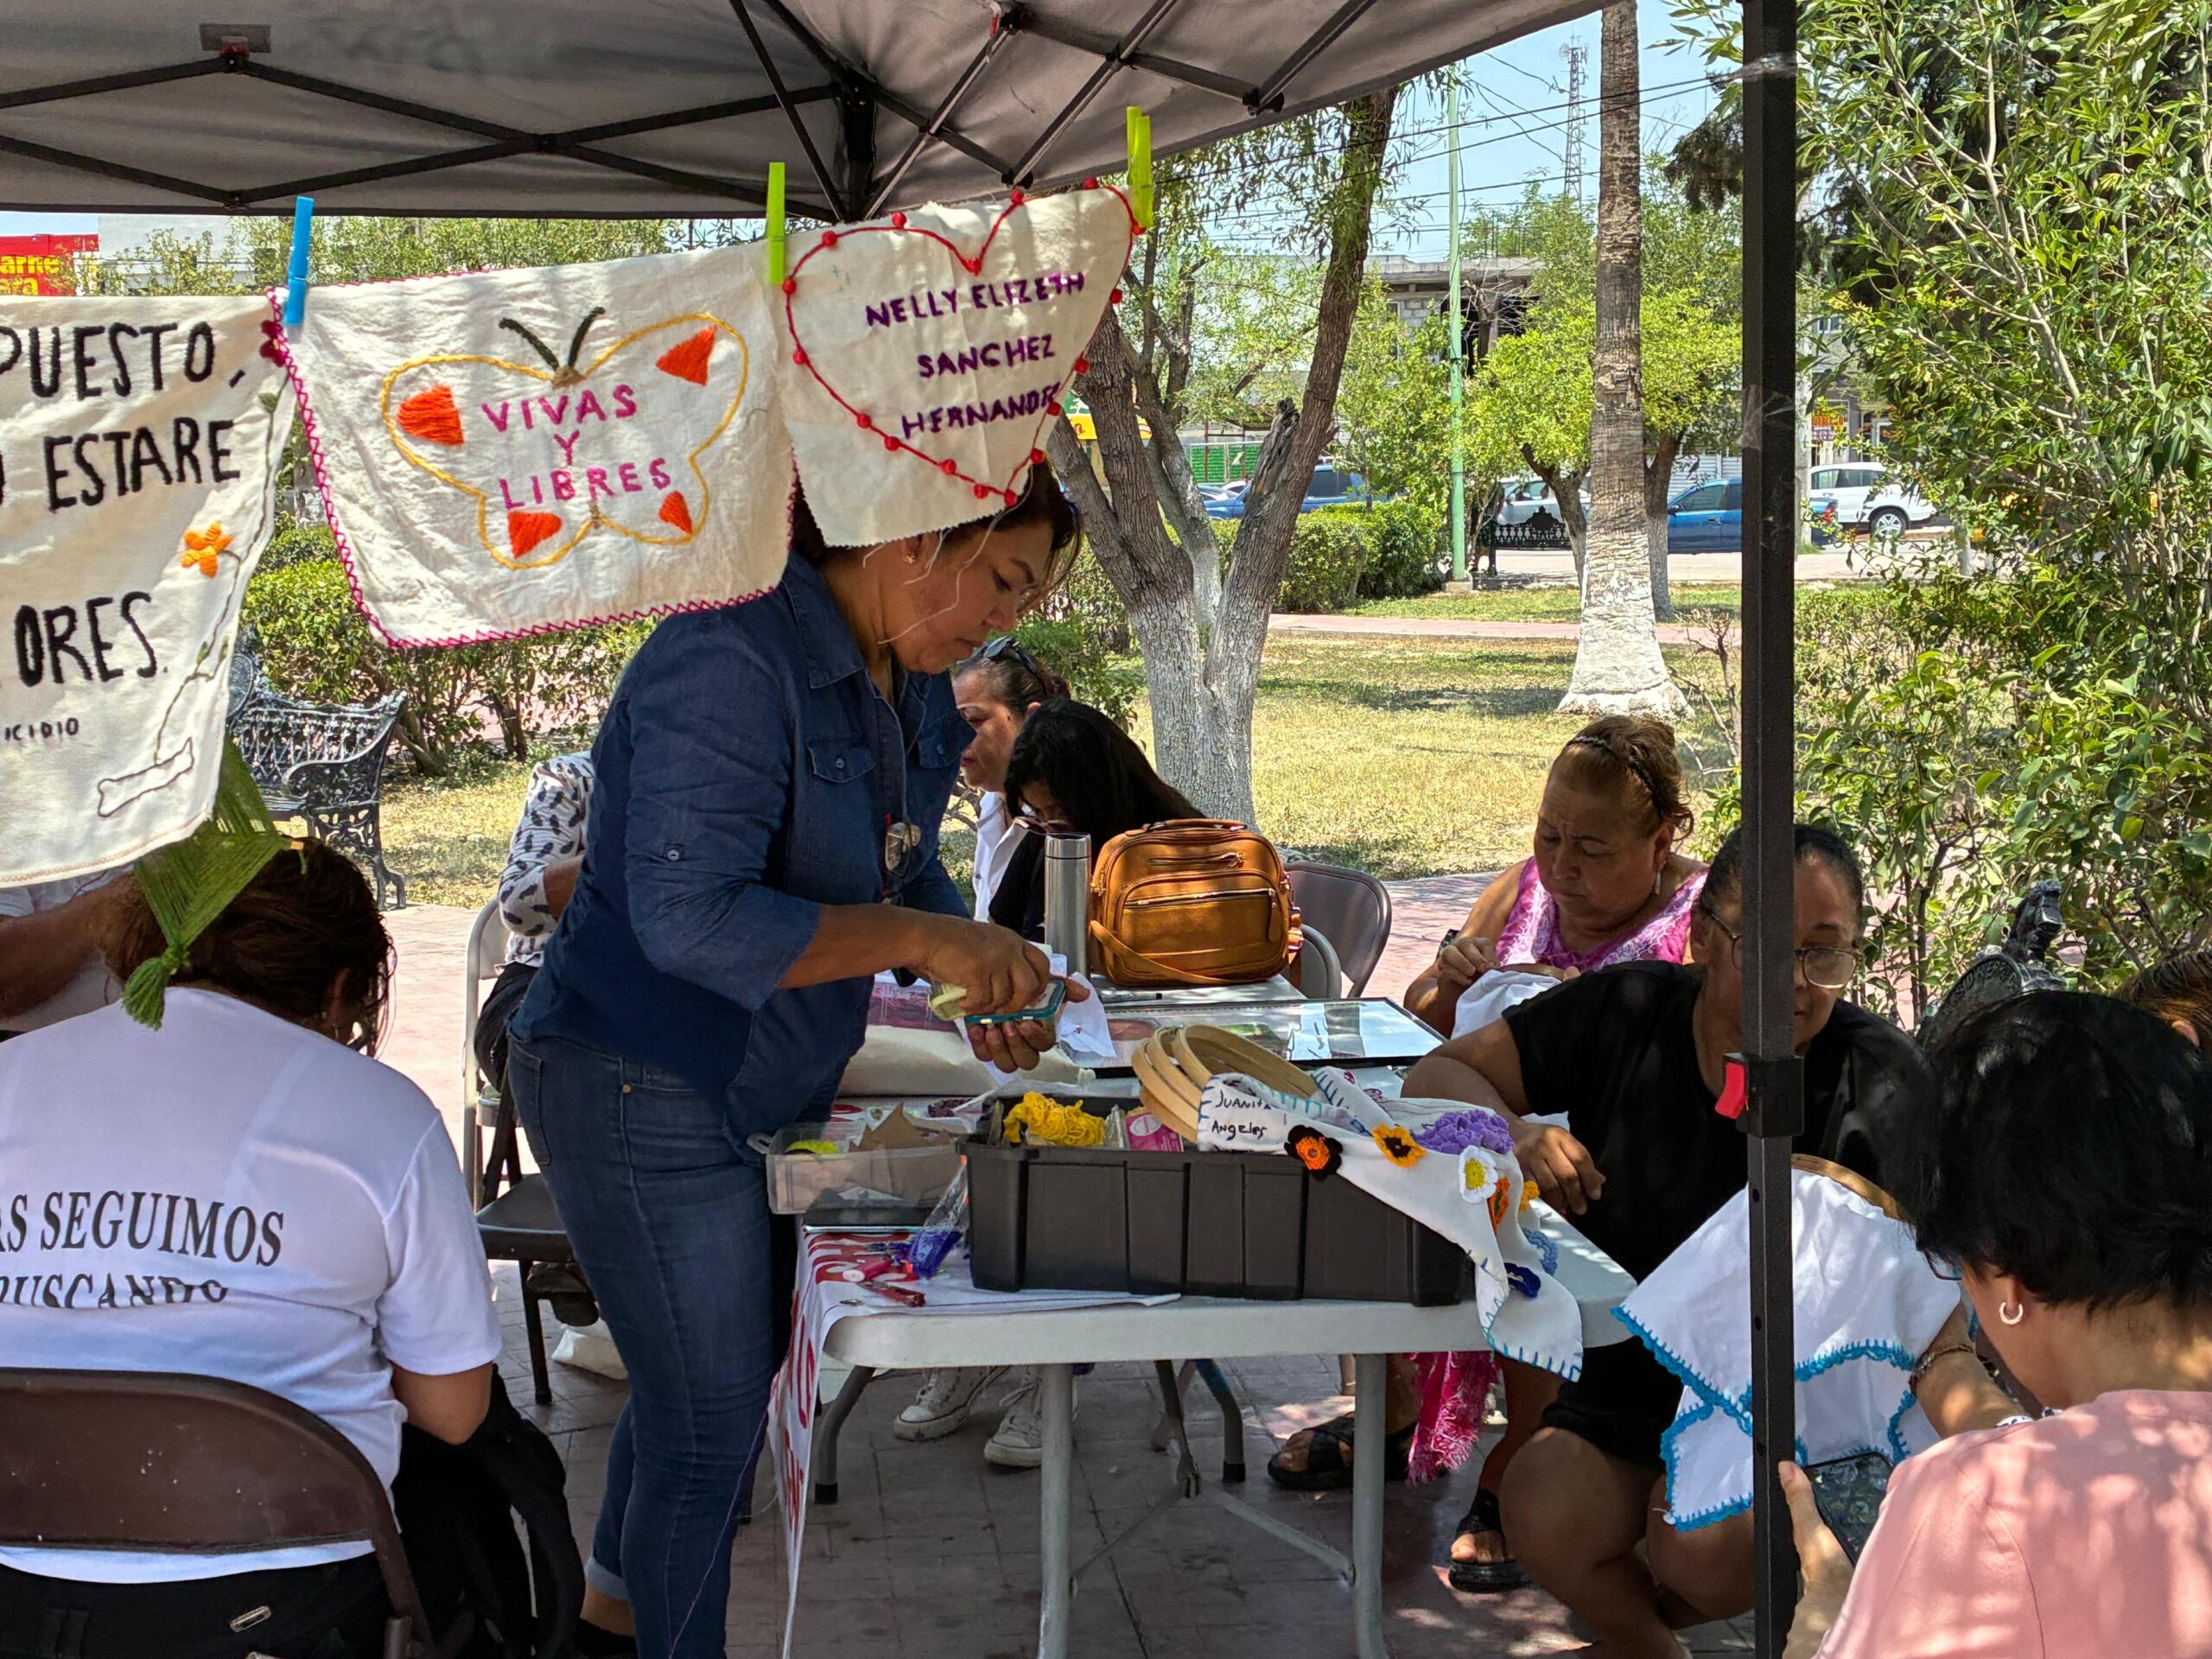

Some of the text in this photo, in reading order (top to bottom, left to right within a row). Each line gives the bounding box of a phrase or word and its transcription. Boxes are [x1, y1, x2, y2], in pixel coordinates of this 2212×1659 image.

[865, 271, 1085, 327] NELLY ELIZETH
[917, 334, 1056, 378] SANCHEZ
[481, 384, 637, 433] VIVAS
[44, 416, 241, 513] ESTARE
[553, 429, 581, 466] Y
[499, 457, 671, 510] LIBRES
[14, 591, 168, 687] ORES.
[4, 716, 79, 741] ICIDIO
[40, 1190, 283, 1268] SEGUIMOS
